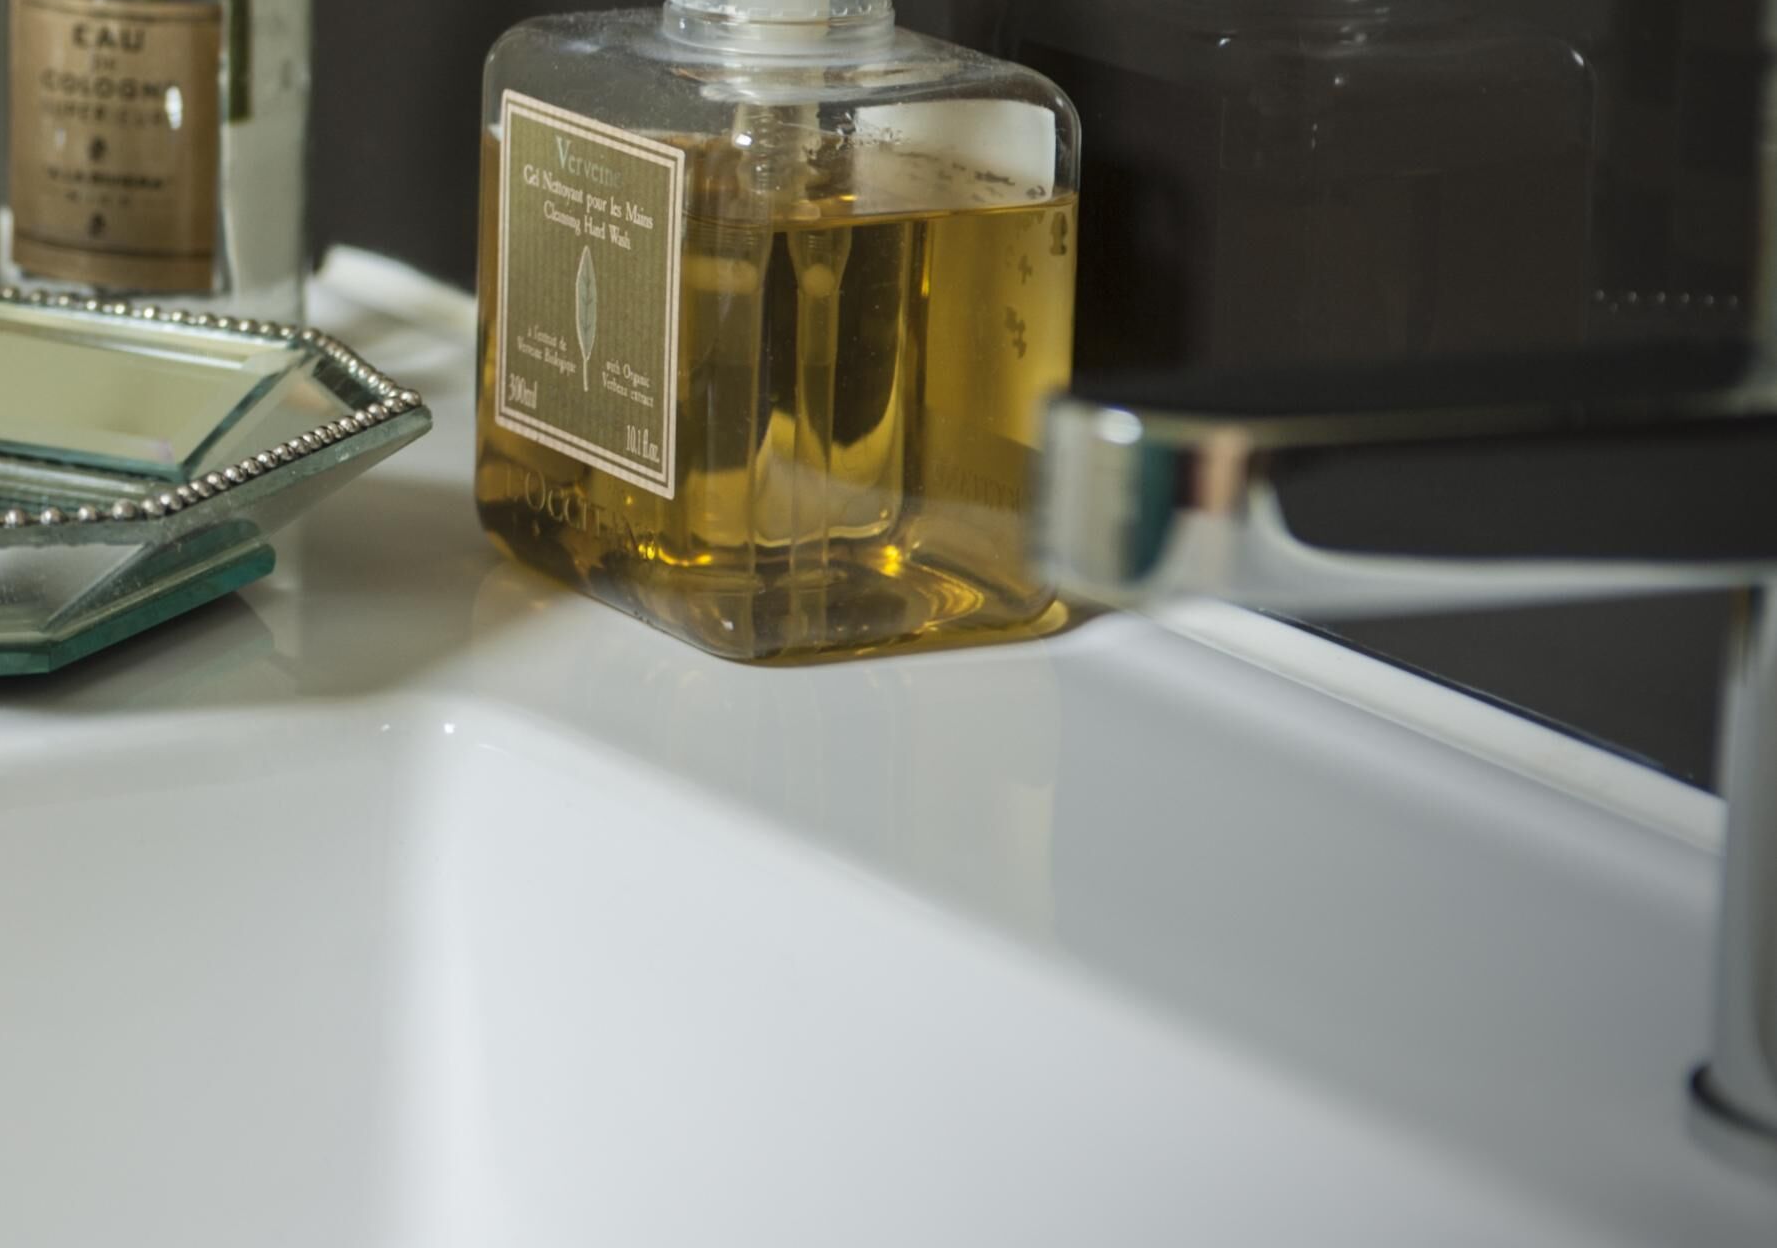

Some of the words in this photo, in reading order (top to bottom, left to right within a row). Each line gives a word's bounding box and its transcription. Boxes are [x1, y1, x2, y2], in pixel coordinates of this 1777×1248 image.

[73, 22, 146, 51] EAU
[586, 193, 607, 213] pour
[610, 196, 622, 217] les
[625, 201, 653, 229] Mains
